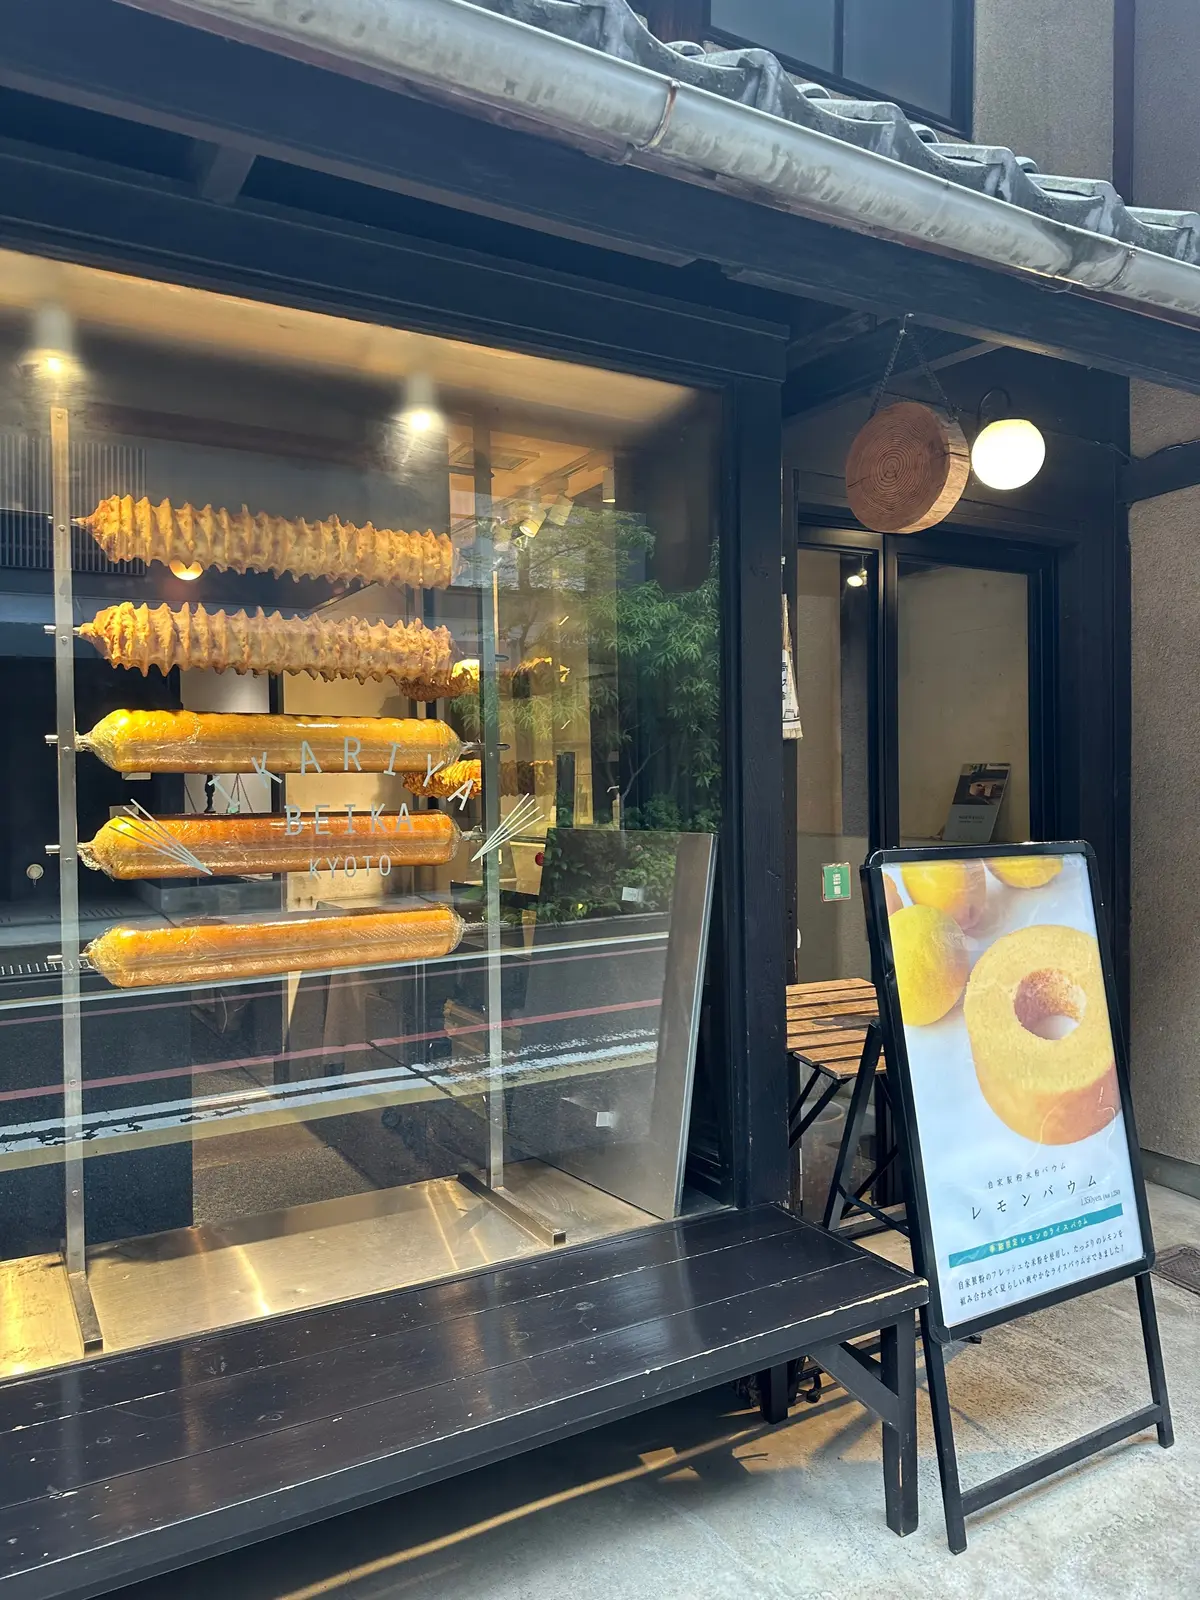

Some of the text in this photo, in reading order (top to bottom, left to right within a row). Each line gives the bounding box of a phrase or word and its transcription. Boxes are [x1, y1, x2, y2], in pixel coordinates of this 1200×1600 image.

[208, 737, 475, 811] IKARIYA
[284, 803, 415, 836] BEIKA
[309, 855, 392, 880] KYOTO
[971, 1175, 1098, 1220] レモンバウム
